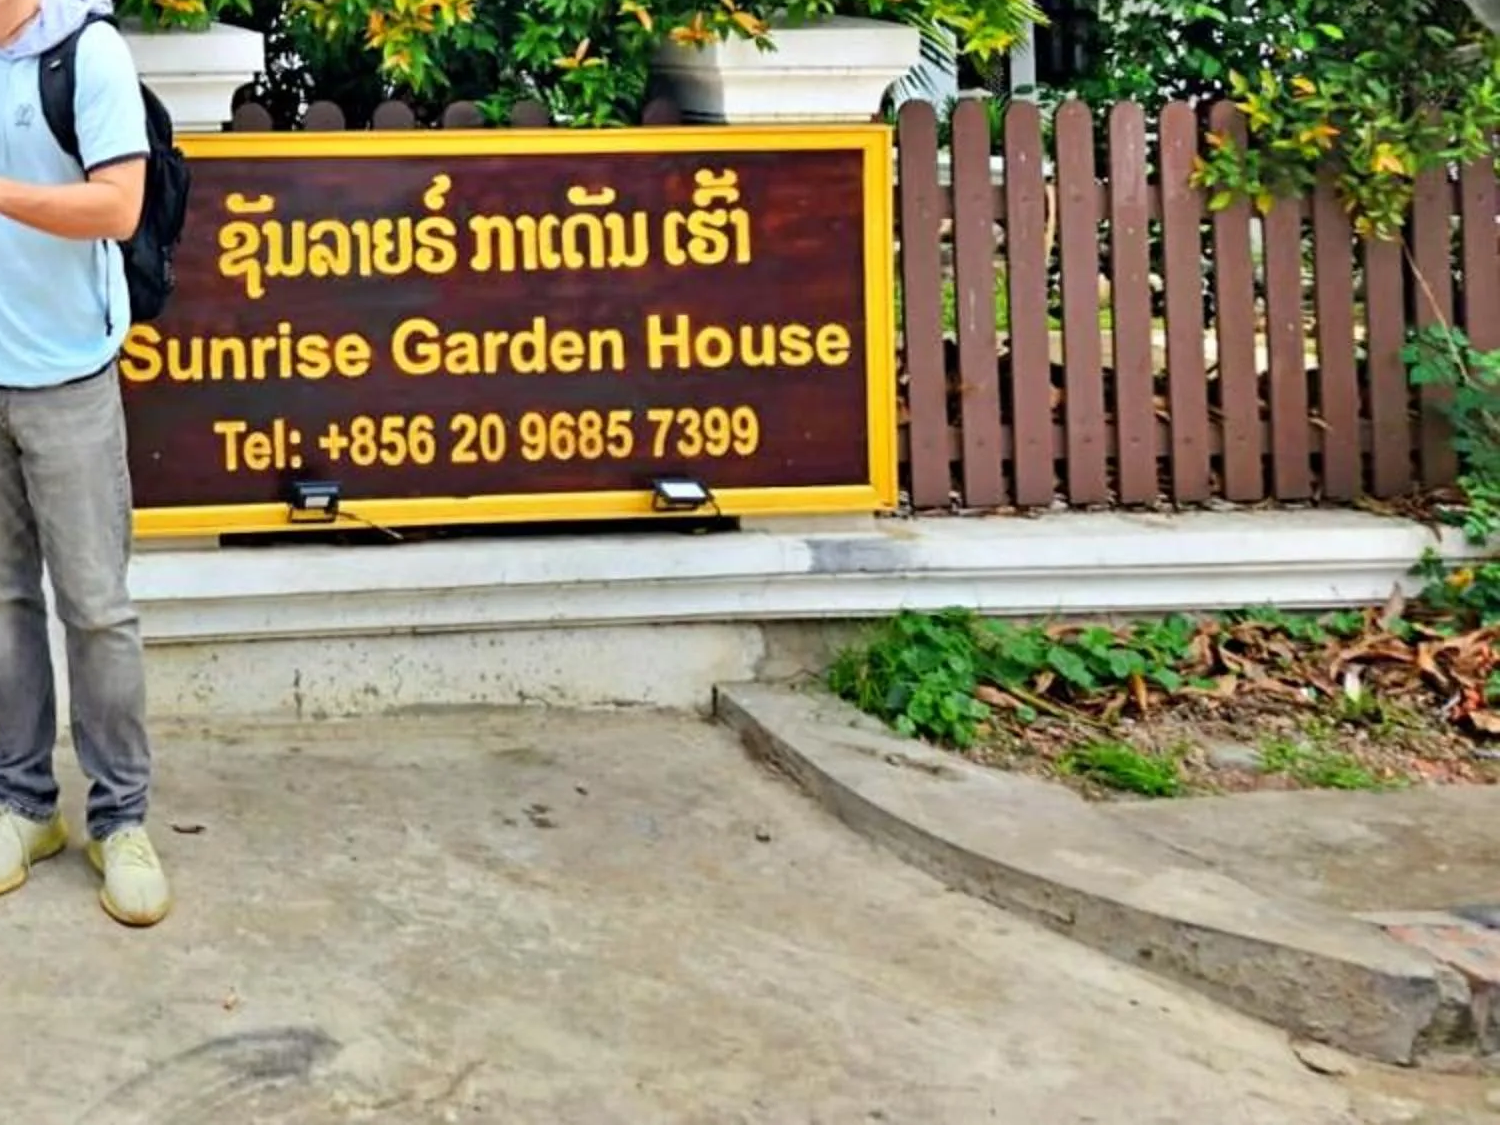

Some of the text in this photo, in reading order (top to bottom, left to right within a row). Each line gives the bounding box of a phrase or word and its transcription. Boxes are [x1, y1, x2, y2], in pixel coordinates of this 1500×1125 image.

[119, 313, 851, 382] Sunrise Garden House
[213, 405, 759, 472] Tel: +856 20 9685 7399
